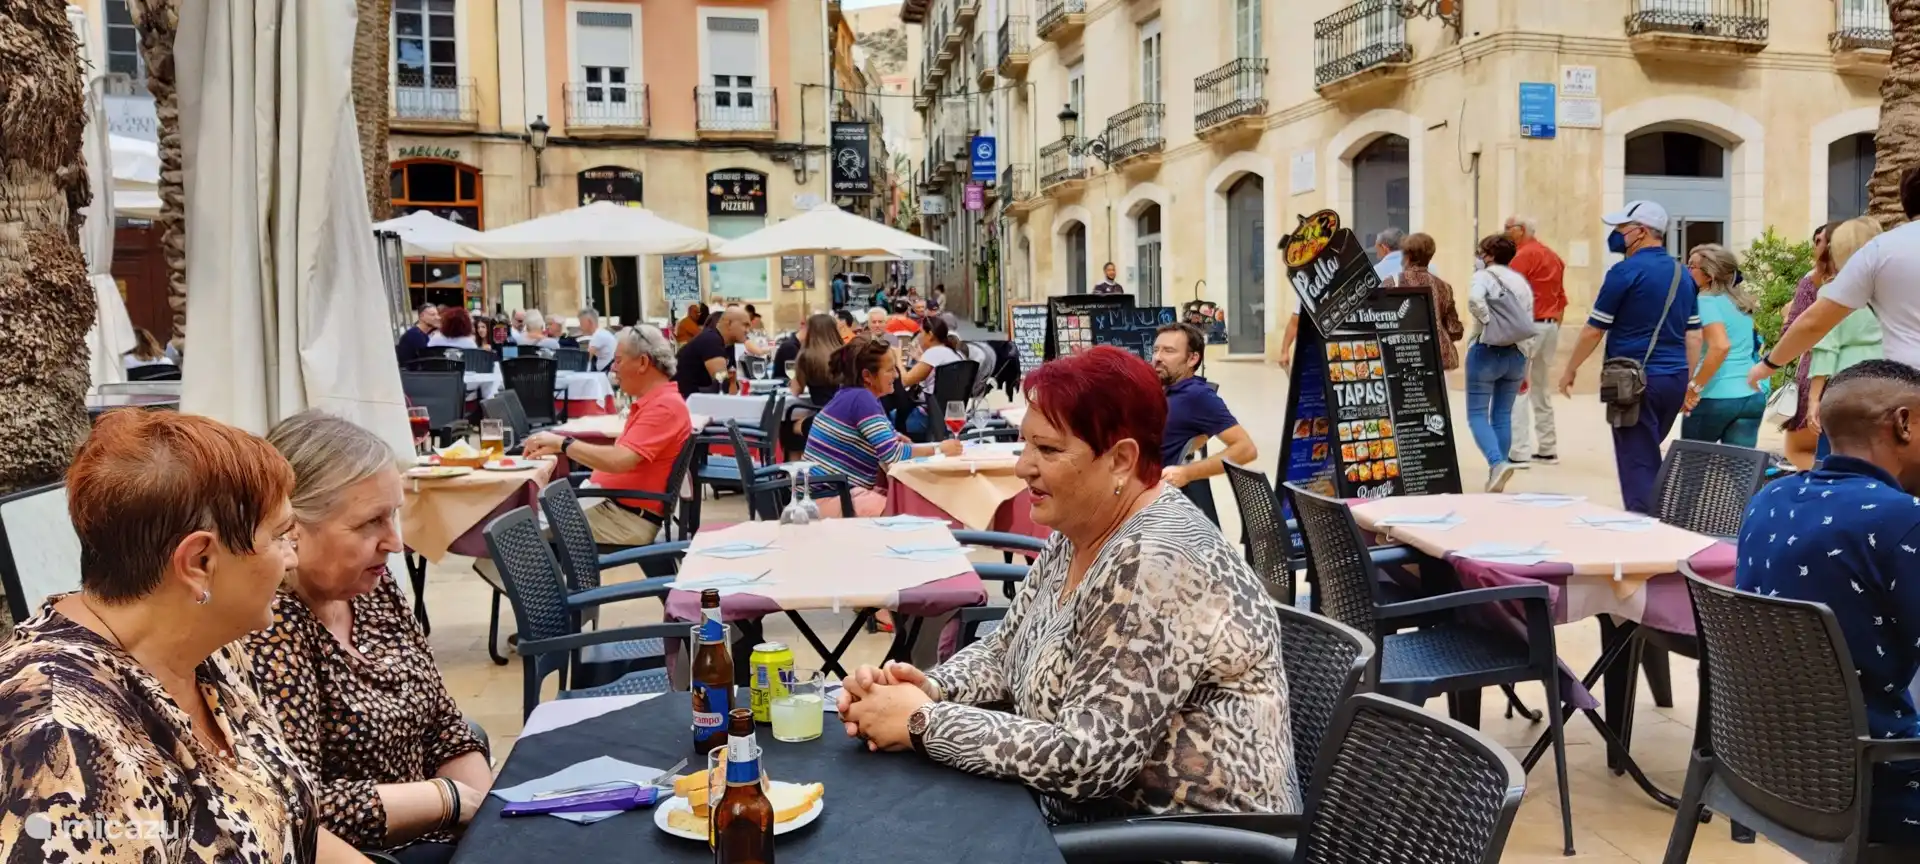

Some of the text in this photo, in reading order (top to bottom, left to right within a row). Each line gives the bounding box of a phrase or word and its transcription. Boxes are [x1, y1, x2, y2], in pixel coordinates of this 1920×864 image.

[398, 146, 460, 159] PAELLAS
[1292, 256, 1339, 313] Paella
[1356, 308, 1398, 322] Taberna
[1333, 381, 1386, 407] TAPAS
